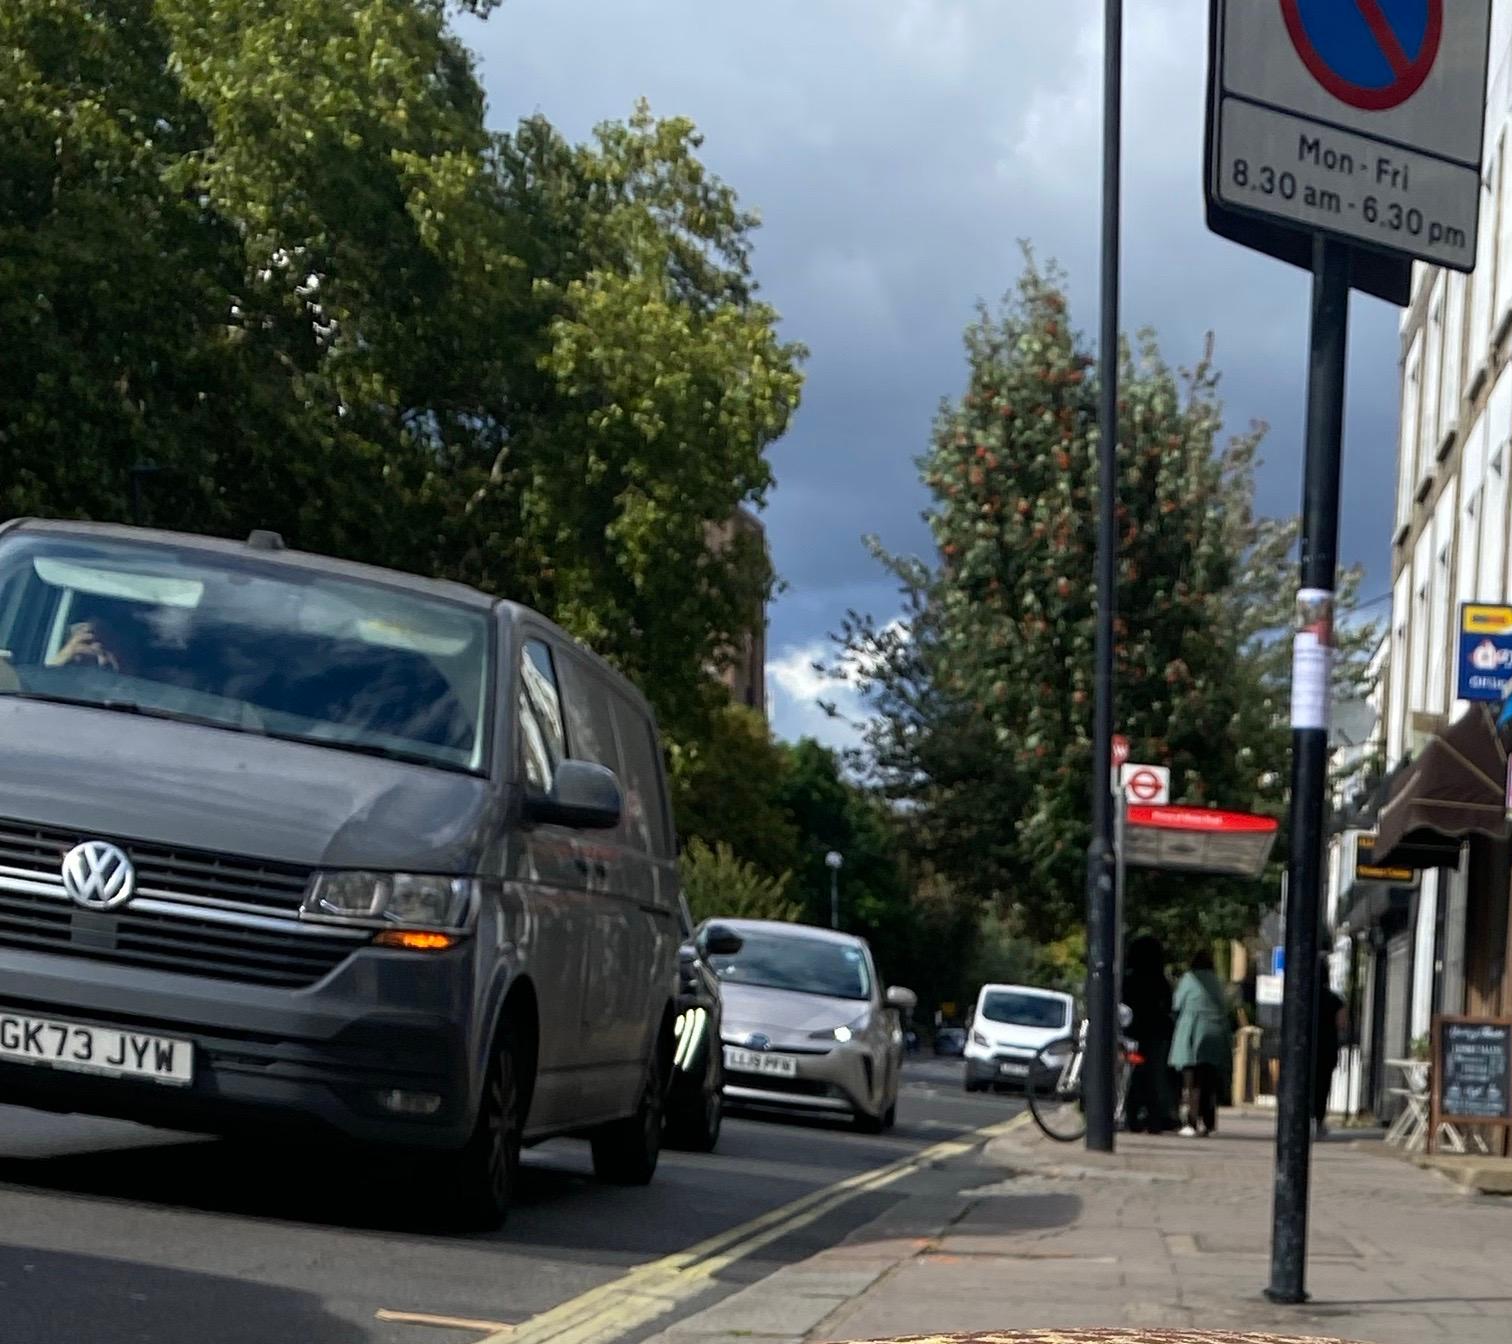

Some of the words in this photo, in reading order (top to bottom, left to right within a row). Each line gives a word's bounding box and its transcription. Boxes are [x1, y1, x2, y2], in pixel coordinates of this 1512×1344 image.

[1298, 134, 1353, 174] Mon
[1376, 157, 1409, 192] Fri
[1233, 158, 1297, 200] 8.30
[1303, 186, 1341, 213] am
[1362, 196, 1423, 236] 6.30
[1428, 221, 1466, 248] pm
[0, 1018, 94, 1062] GK73
[106, 1034, 175, 1073] JYW
